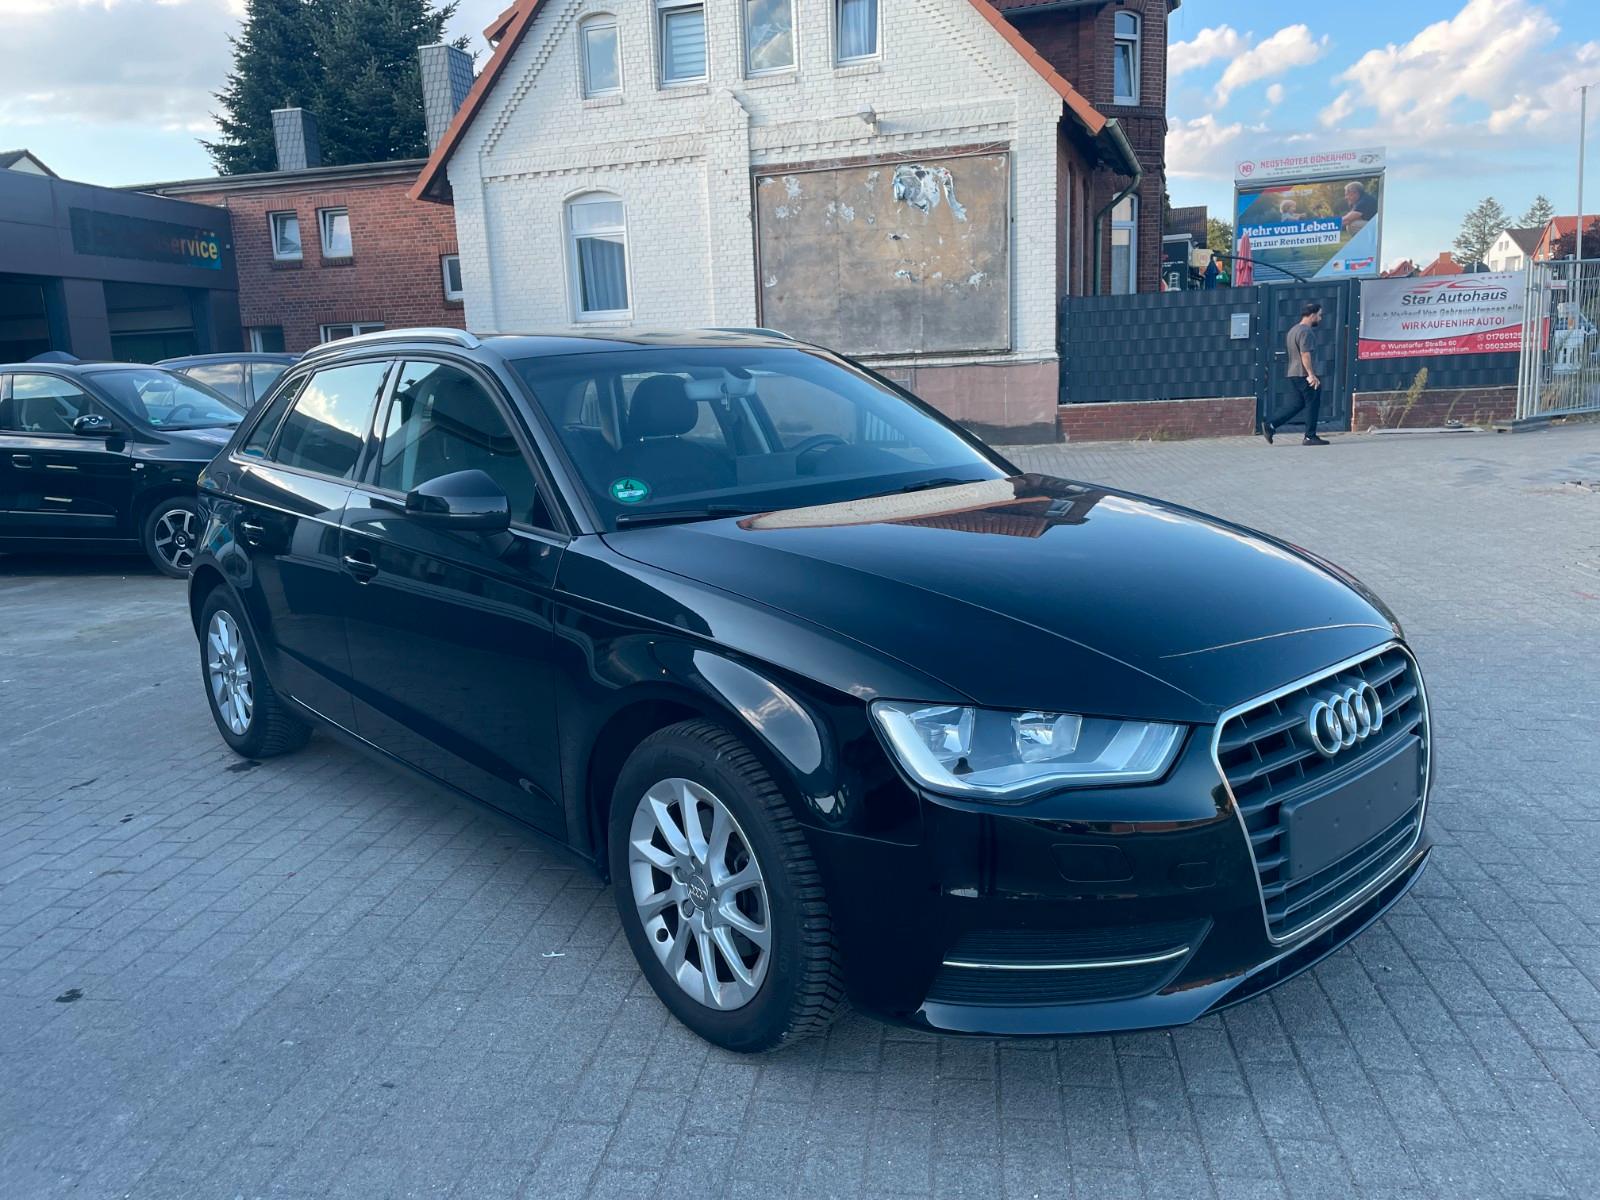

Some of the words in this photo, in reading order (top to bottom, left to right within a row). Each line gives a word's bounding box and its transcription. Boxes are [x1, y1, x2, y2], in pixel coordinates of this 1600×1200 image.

[1242, 225, 1272, 237] Mehr
[1274, 225, 1298, 235] vom
[1301, 221, 1339, 232] Leben.
[1250, 238, 1262, 248] ein
[1263, 240, 1279, 248] zur
[1280, 237, 1305, 247] Rente
[1306, 235, 1322, 244] mit
[1323, 234, 1337, 243] 70!
[1401, 292, 1433, 306] Star
[1436, 290, 1508, 304] Autohaus
[1402, 321, 1420, 330] WIR
[1420, 319, 1458, 330] KAUFEN
[1459, 318, 1475, 328] IHR
